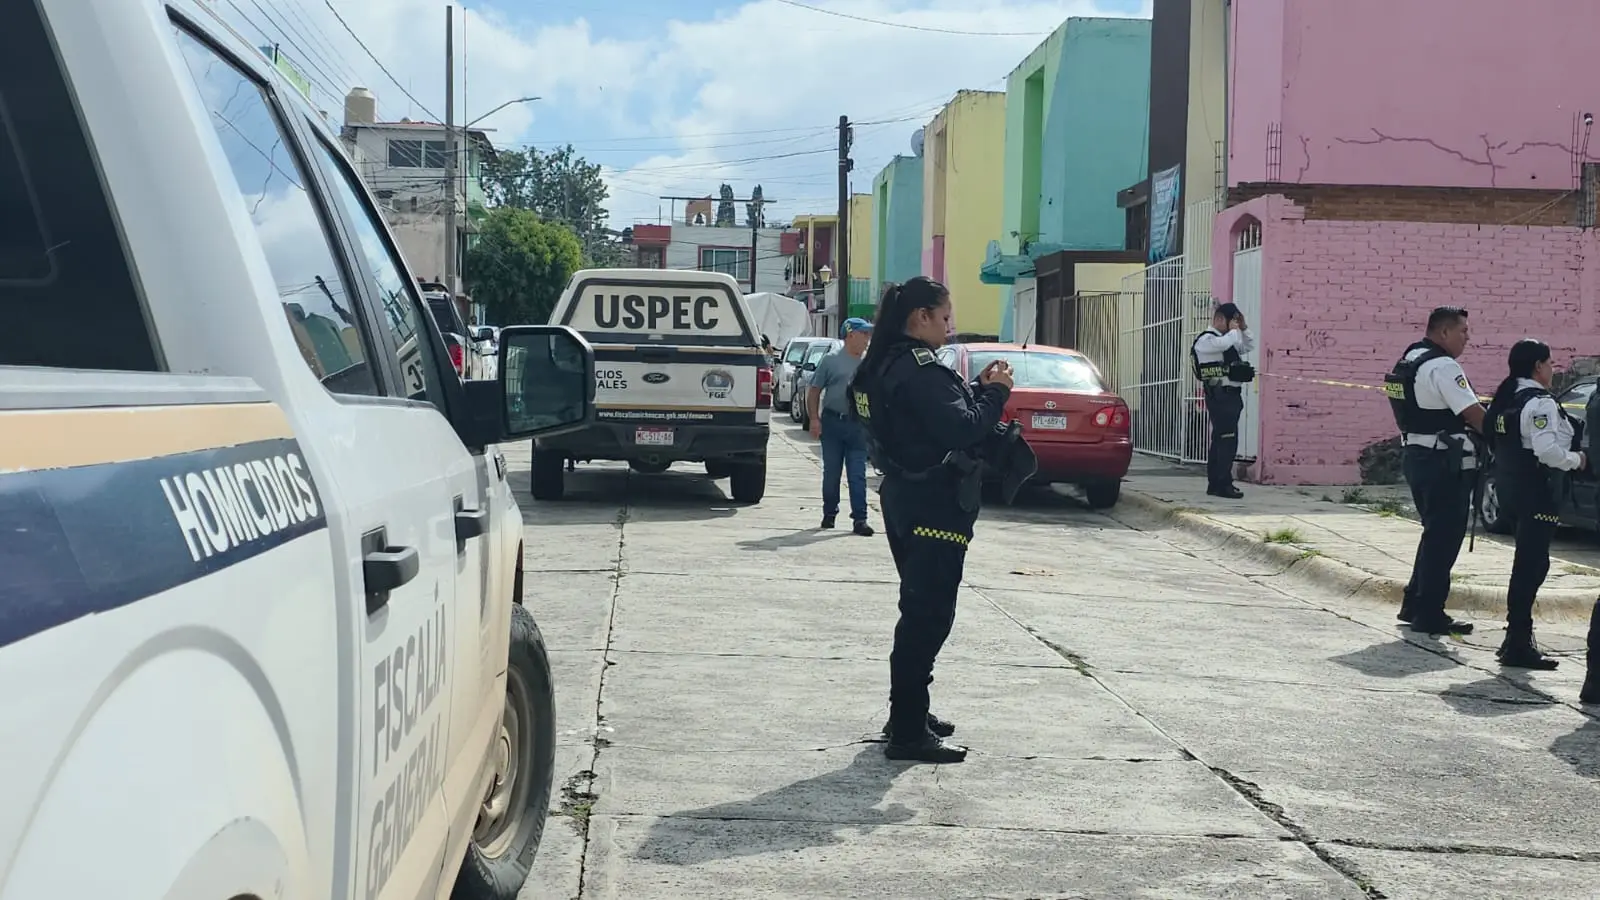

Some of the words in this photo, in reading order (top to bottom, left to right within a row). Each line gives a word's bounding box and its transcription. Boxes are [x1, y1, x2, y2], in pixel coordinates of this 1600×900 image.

[594, 294, 719, 330] USPEC
[708, 391, 727, 399] FGE
[159, 453, 318, 562] HOMICIDIOS
[373, 577, 447, 778] FISCALÍA
[365, 712, 442, 900] GENERAL
